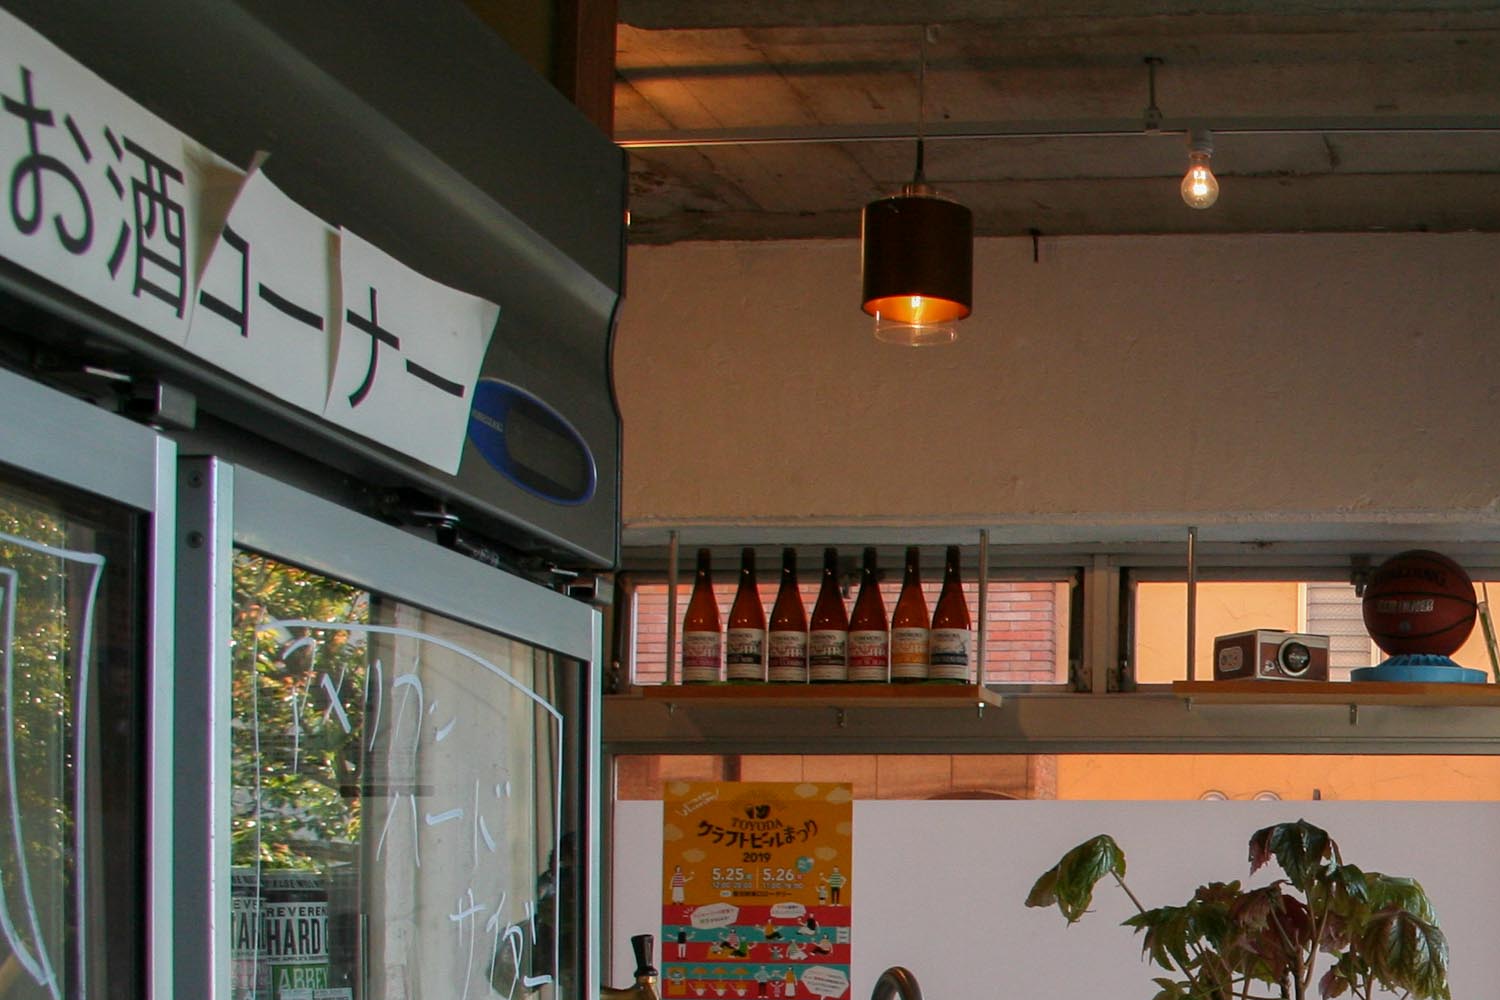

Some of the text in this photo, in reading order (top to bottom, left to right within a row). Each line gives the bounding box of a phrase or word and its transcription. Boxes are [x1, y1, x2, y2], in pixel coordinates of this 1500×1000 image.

[1, 64, 465, 408] お酒コーナー
[376, 780, 512, 870] ハード
[697, 819, 818, 849] クラフトビールまつり
[743, 852, 772, 863] 2019
[712, 868, 744, 881] 5.25
[763, 868, 794, 881] 5.26
[267, 918, 321, 955] HARD
